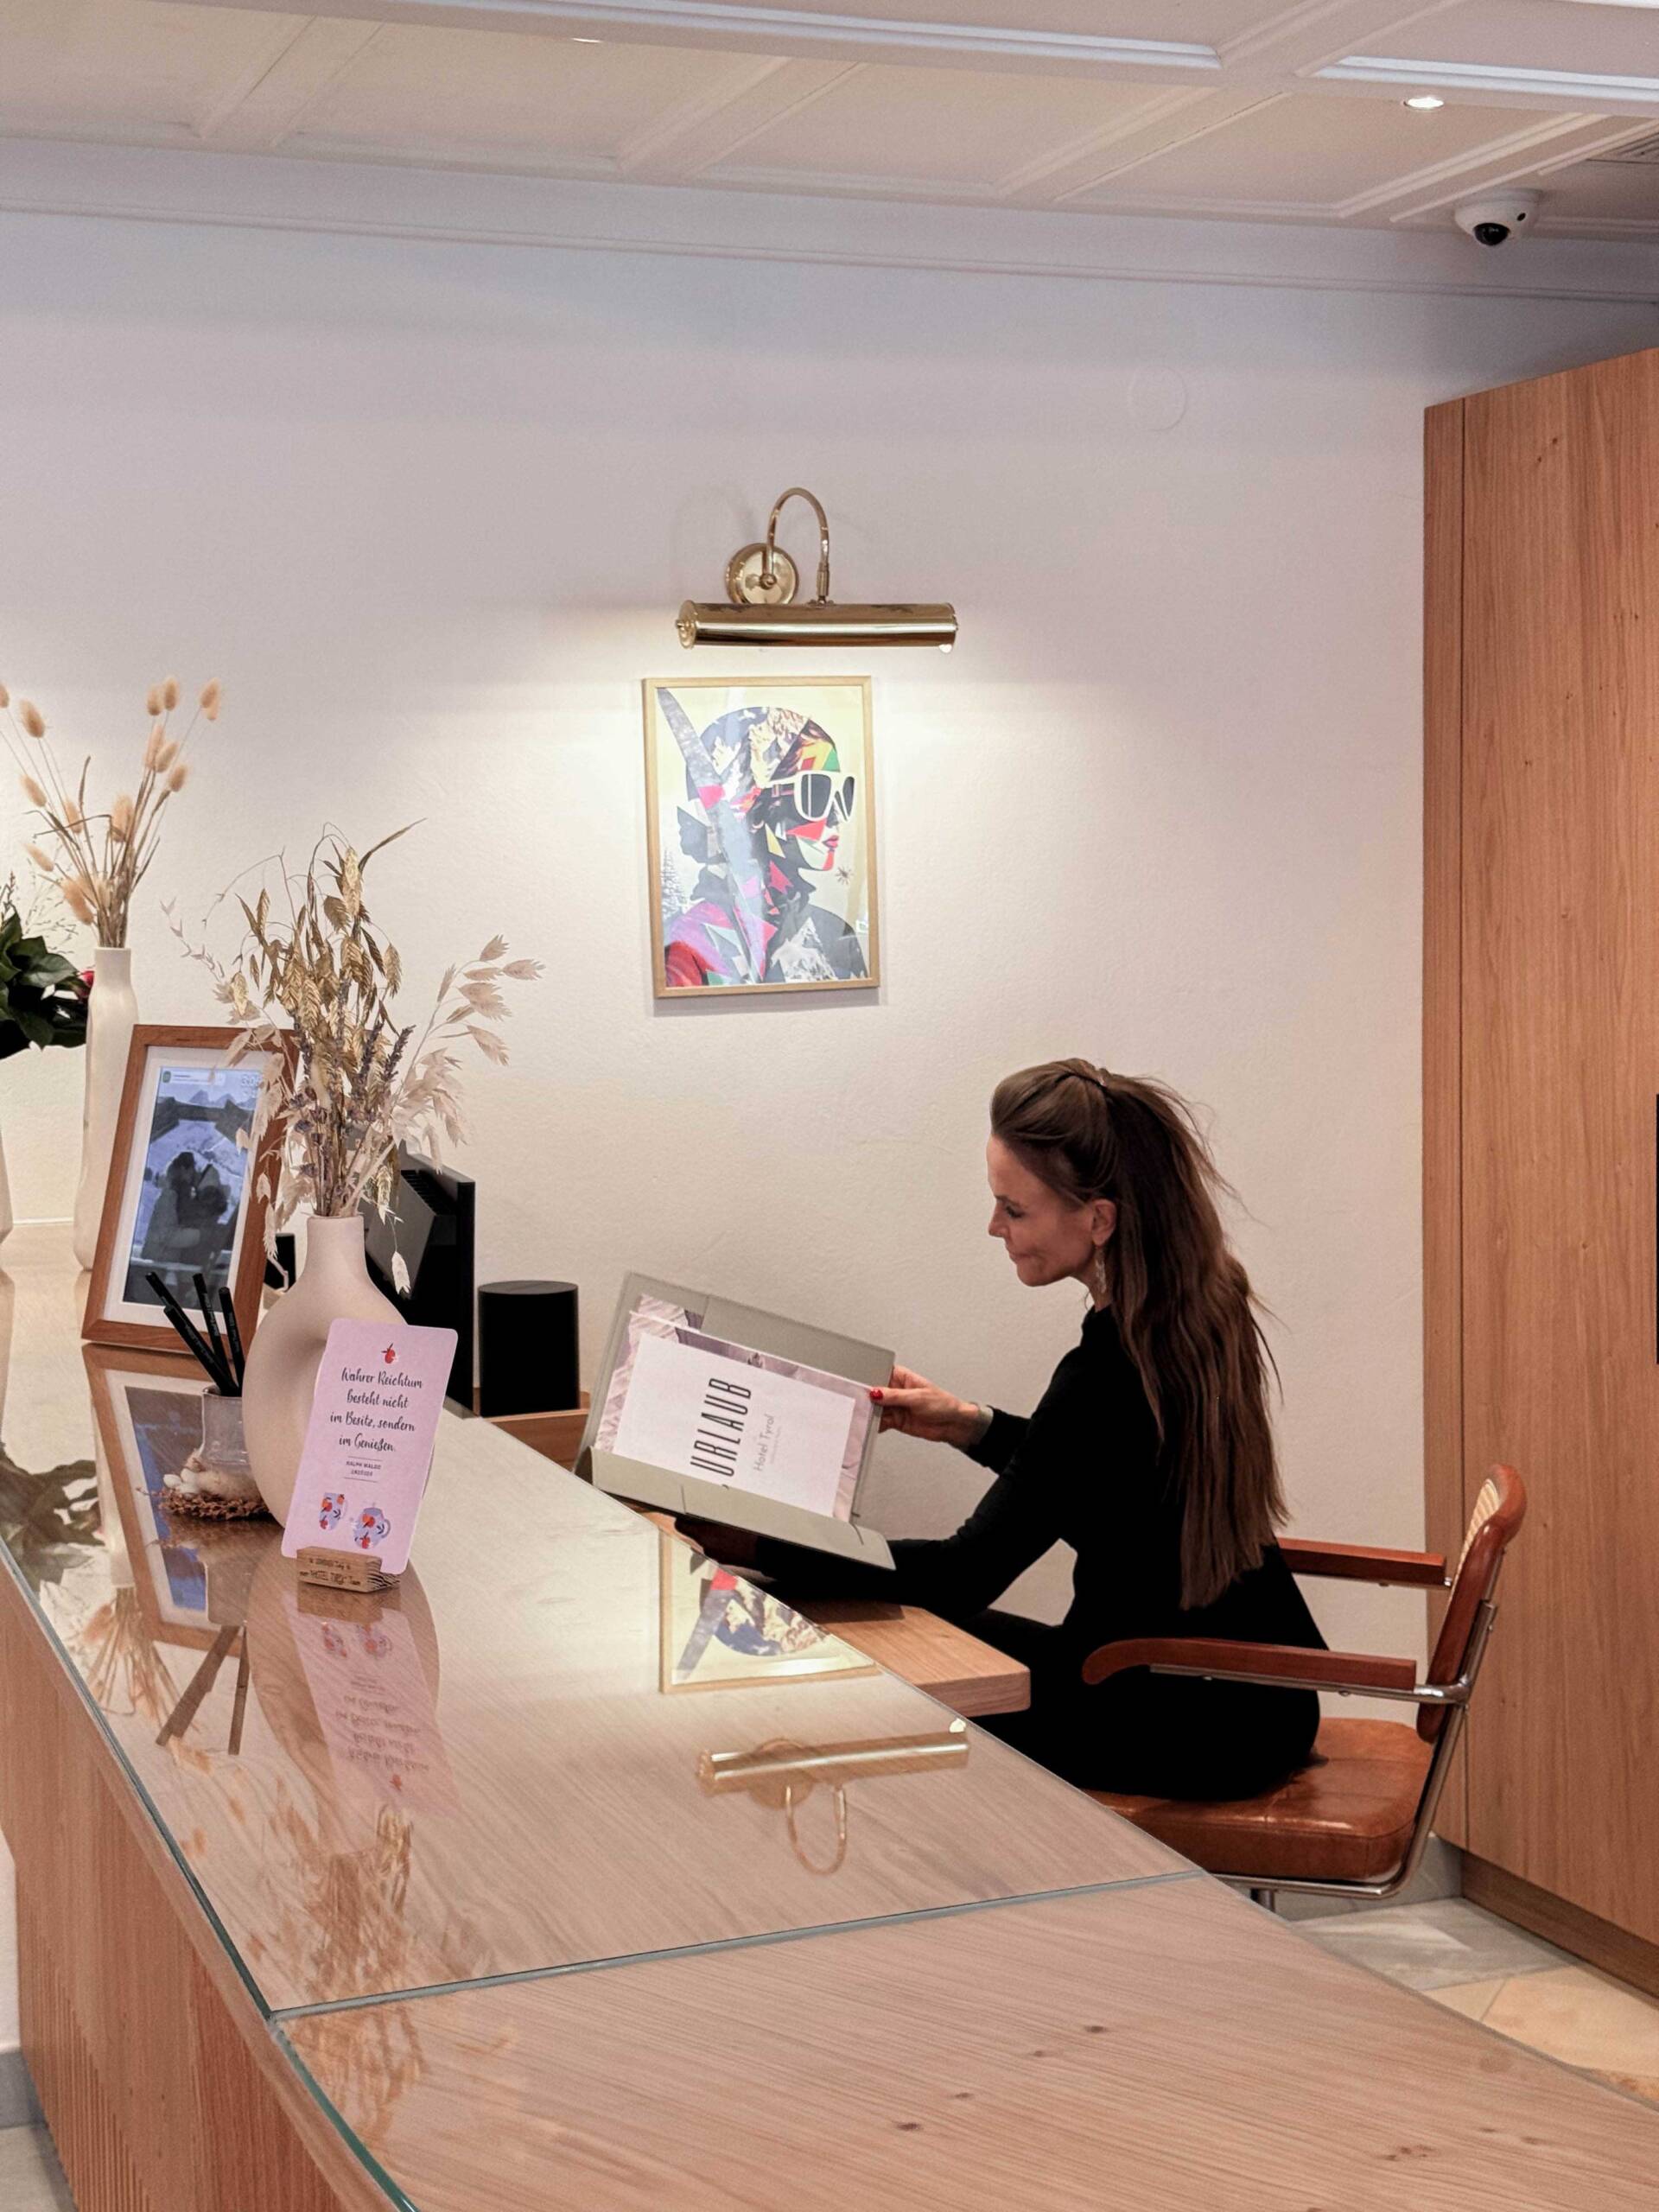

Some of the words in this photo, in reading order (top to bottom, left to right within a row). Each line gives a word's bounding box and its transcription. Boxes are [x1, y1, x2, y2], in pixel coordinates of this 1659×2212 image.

[340, 1367, 375, 1383] Wahrer
[378, 1370, 423, 1389] Reichtum
[346, 1388, 380, 1406] besteht
[382, 1394, 409, 1408] nicht
[330, 1411, 342, 1424] im
[345, 1410, 375, 1429] Besitz,
[377, 1415, 415, 1432] sondern
[690, 1377, 752, 1477] URLAUB
[760, 1412, 774, 1440] Tyrol
[339, 1434, 351, 1446] im
[354, 1432, 395, 1452] Genießen.
[753, 1442, 768, 1471] Hotel
